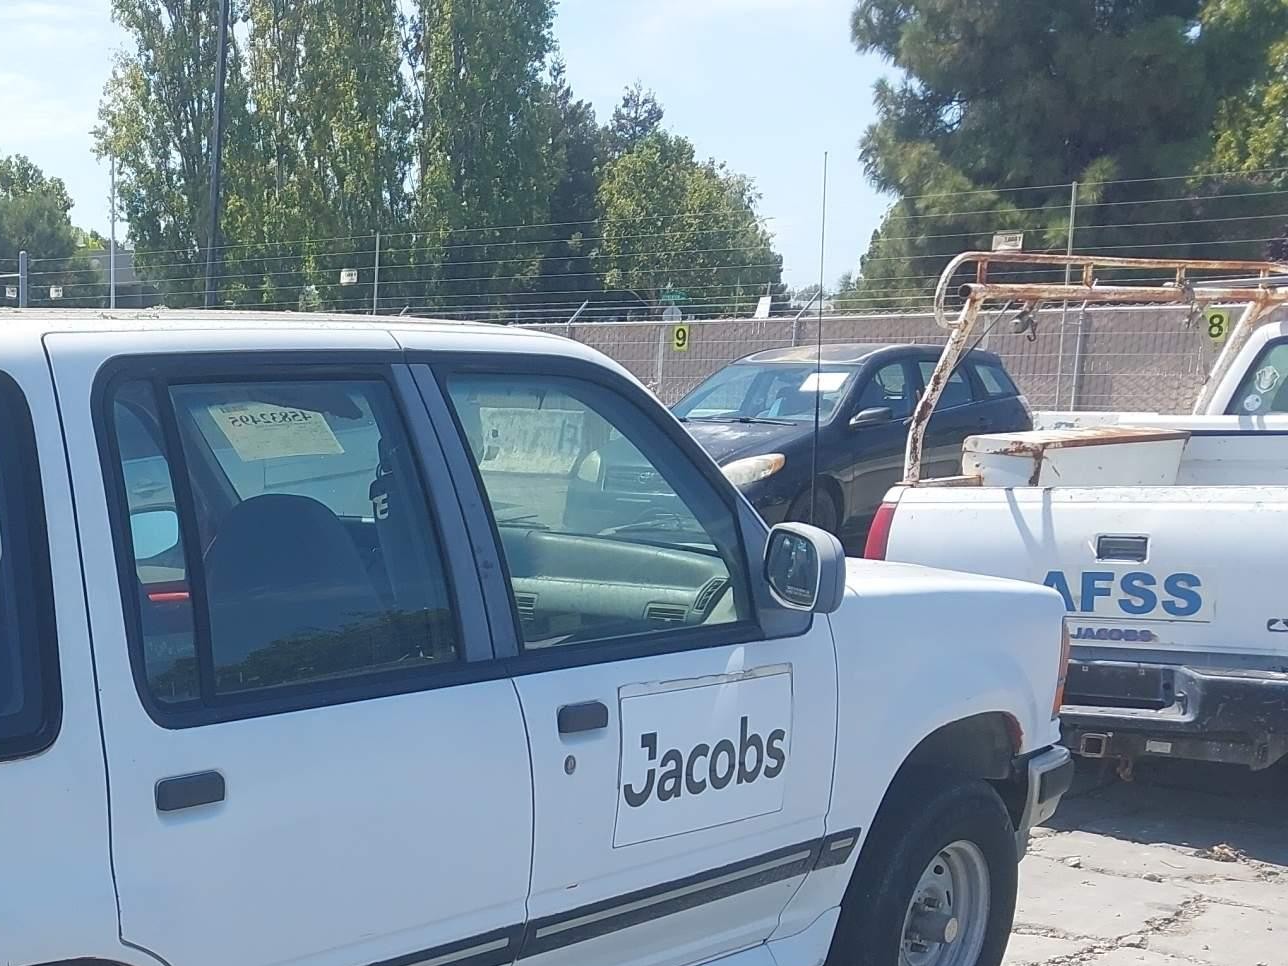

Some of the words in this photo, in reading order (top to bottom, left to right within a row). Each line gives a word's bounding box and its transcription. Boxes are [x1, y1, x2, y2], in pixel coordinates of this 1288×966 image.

[675, 328, 687, 347] 9
[1208, 314, 1224, 338] 8
[1043, 570, 1203, 617] AFSS
[623, 716, 786, 808] Jacobs
